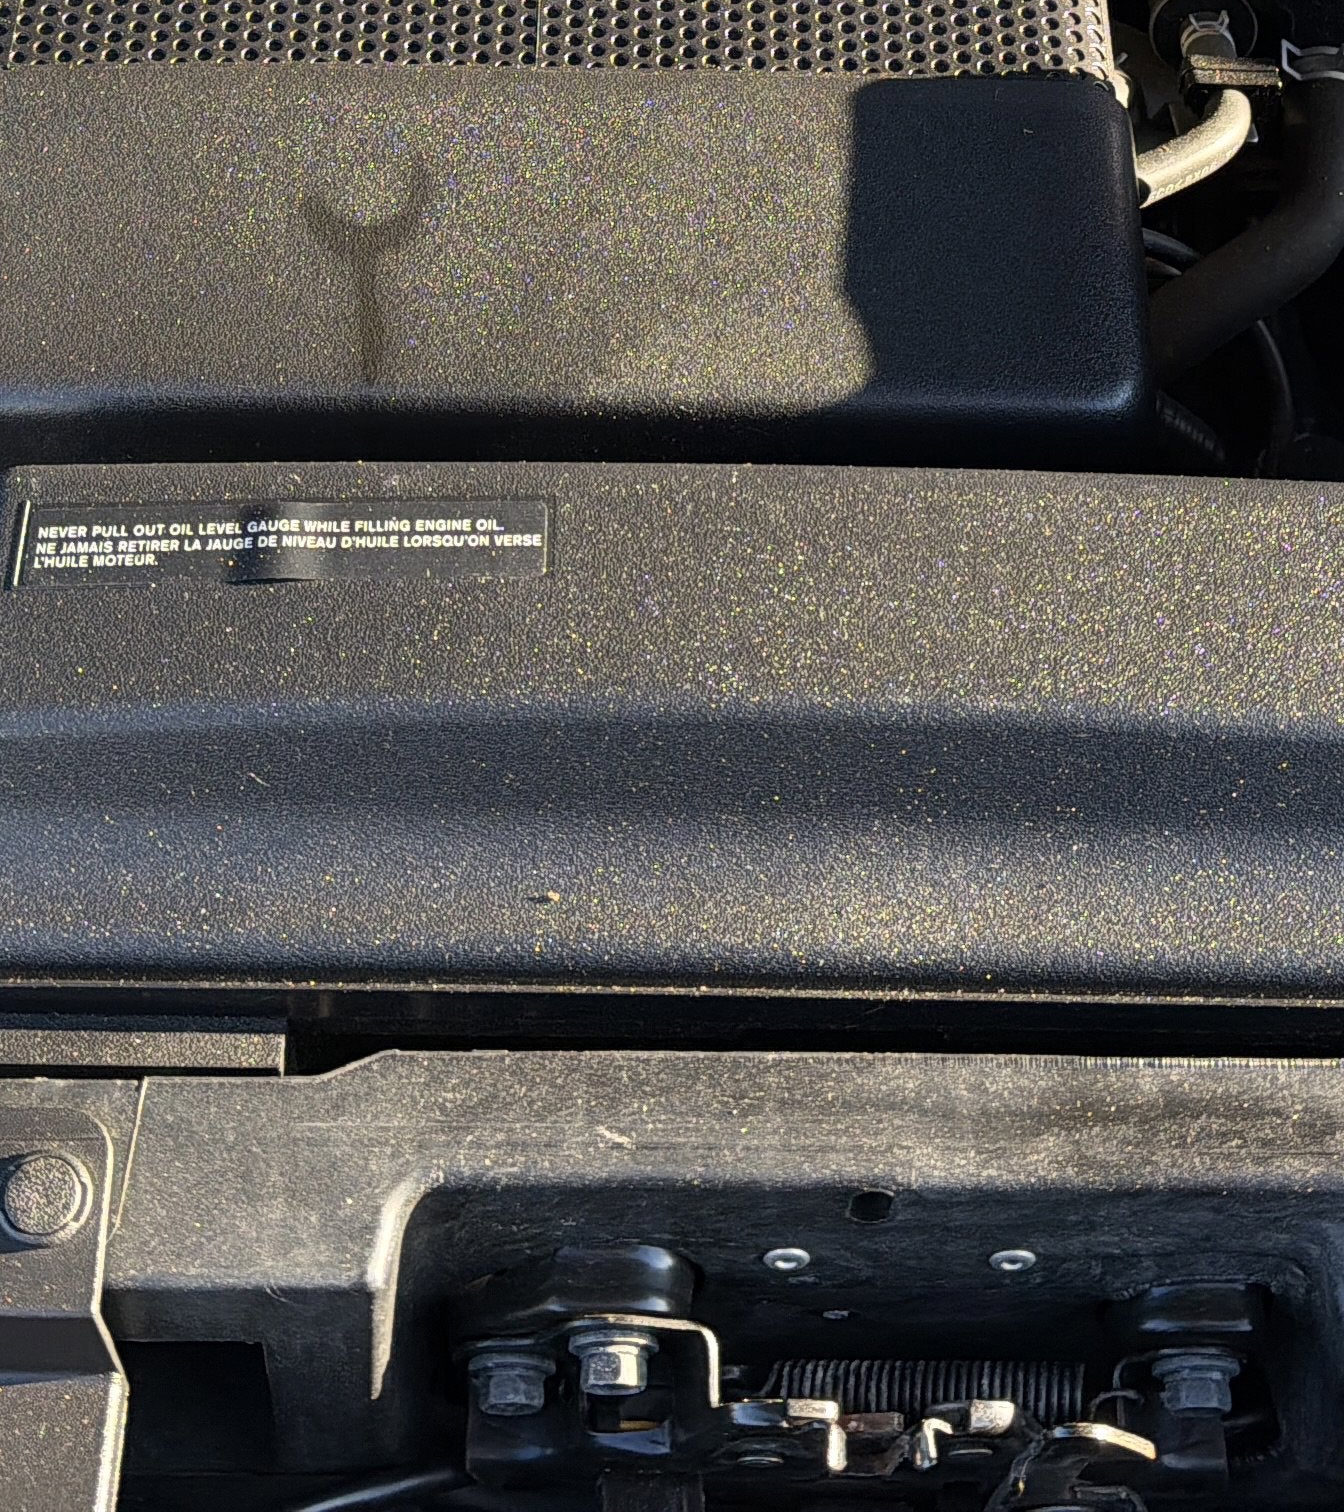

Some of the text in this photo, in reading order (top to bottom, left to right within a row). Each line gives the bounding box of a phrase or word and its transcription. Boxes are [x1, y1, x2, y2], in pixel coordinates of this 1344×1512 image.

[37, 518, 505, 539] NEVER PULL OUT OIL LEVEL GAUGE WHILE FILLING ENGINE OIL.
[35, 533, 543, 555] NE JAMAIS RETIRER LA JAUGE DE NIVEAU D'HUILE LORSQU'ON VERSE
[33, 553, 159, 569] L'HUILE MOTEUR.
